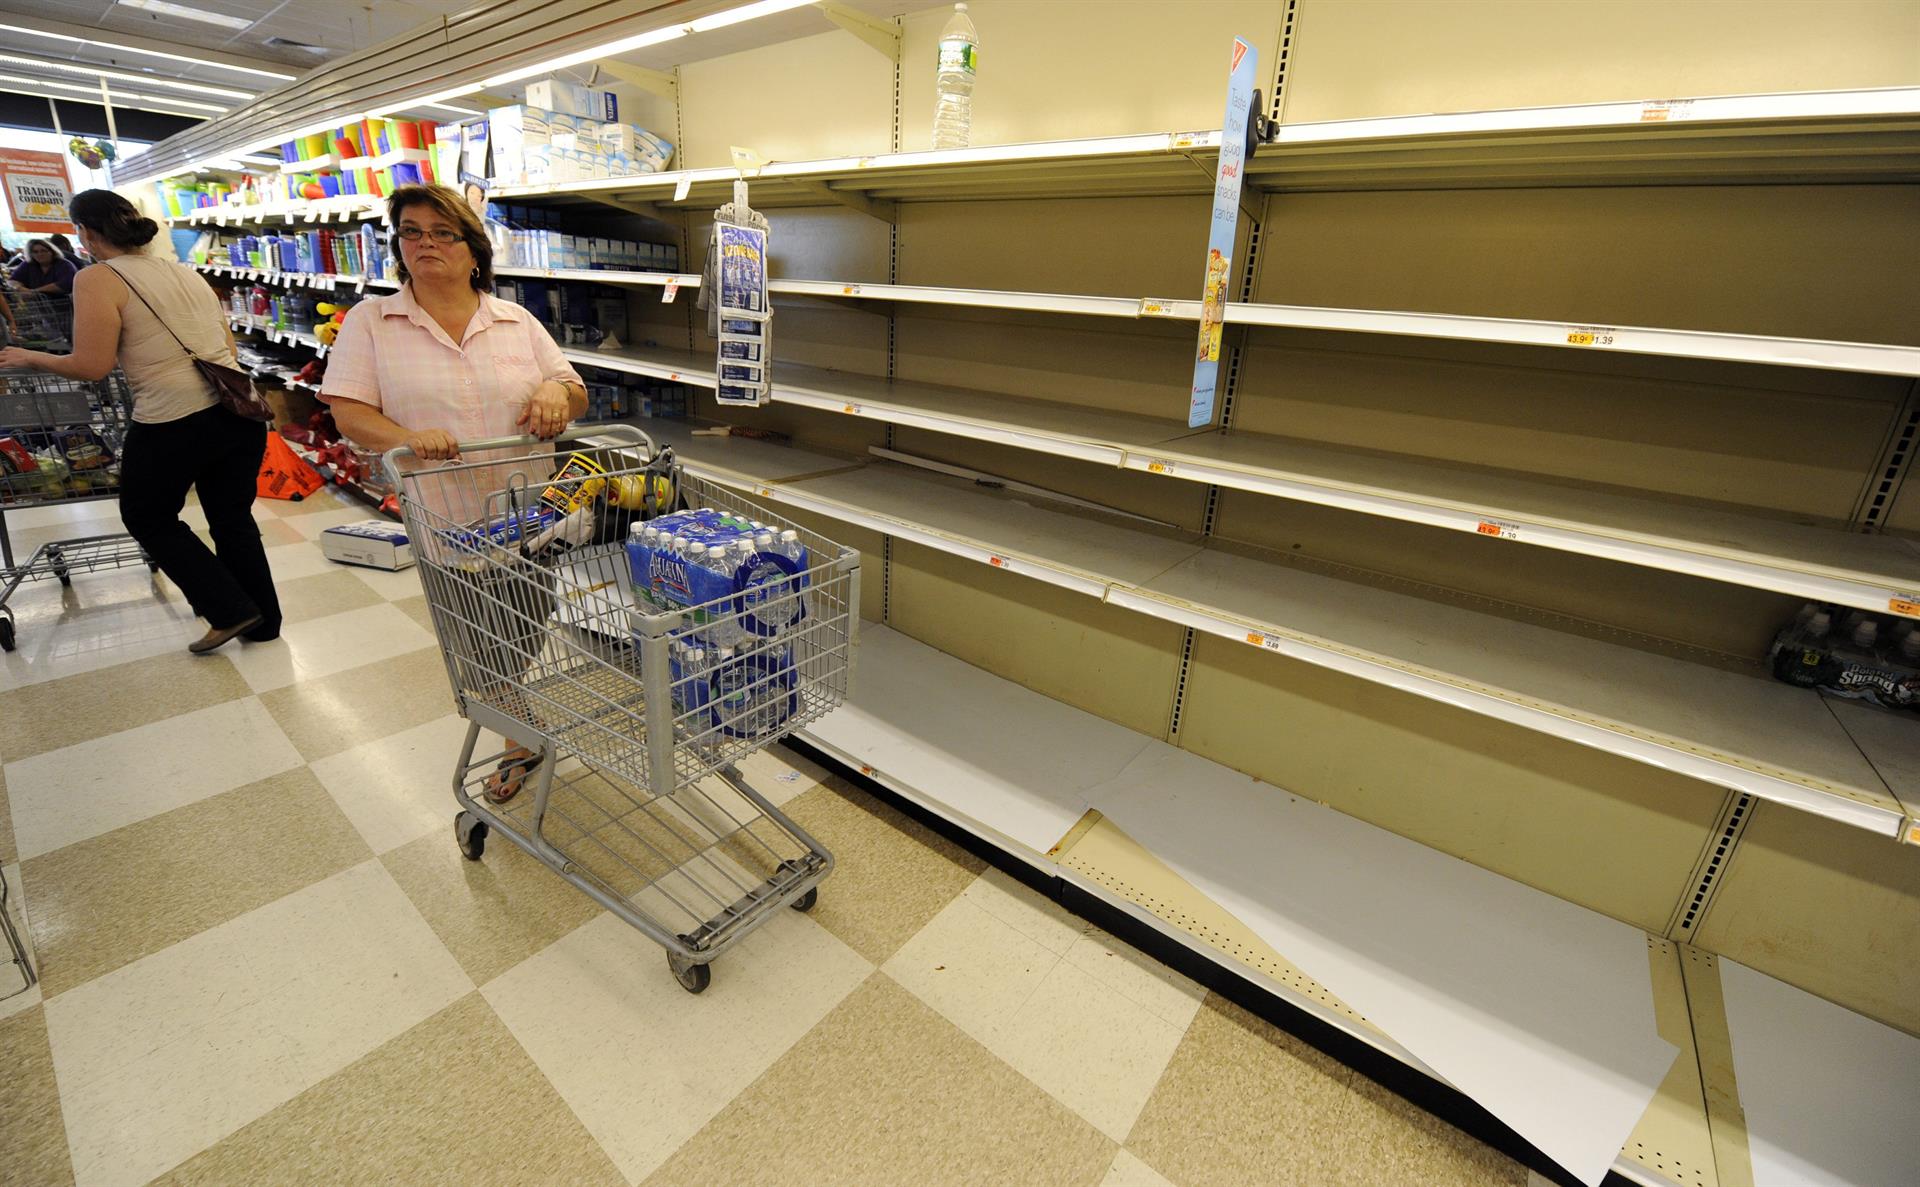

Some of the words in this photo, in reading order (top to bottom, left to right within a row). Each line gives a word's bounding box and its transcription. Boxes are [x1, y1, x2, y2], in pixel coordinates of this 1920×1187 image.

[1231, 87, 1247, 112] Taste
[1228, 113, 1242, 134] how
[1221, 160, 1240, 181] good
[15, 185, 64, 198] TRADING
[1217, 184, 1237, 202] snacks
[19, 195, 64, 207] company
[1595, 336, 1613, 345] 1.39
[1850, 663, 1895, 681] Poland
[1839, 671, 1895, 695] Spring
